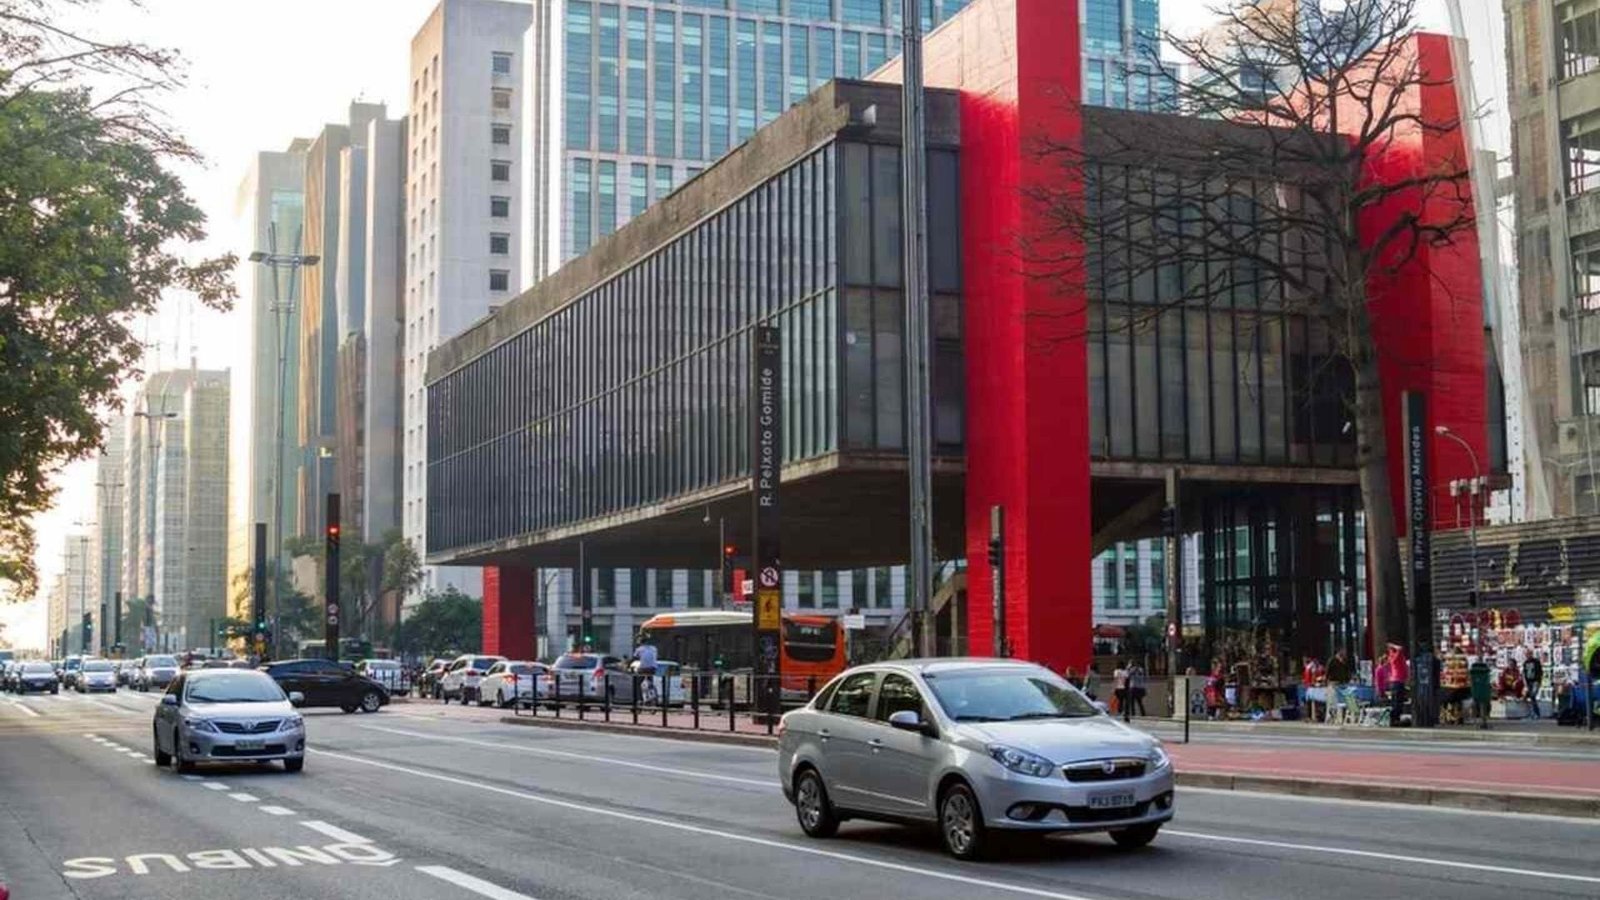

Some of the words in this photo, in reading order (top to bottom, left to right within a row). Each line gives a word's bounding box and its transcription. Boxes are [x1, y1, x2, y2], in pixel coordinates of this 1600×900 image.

[759, 368, 773, 426] Gomide
[759, 430, 773, 490] Peixoto
[1411, 425, 1421, 475] Mendes
[759, 493, 773, 507] R.
